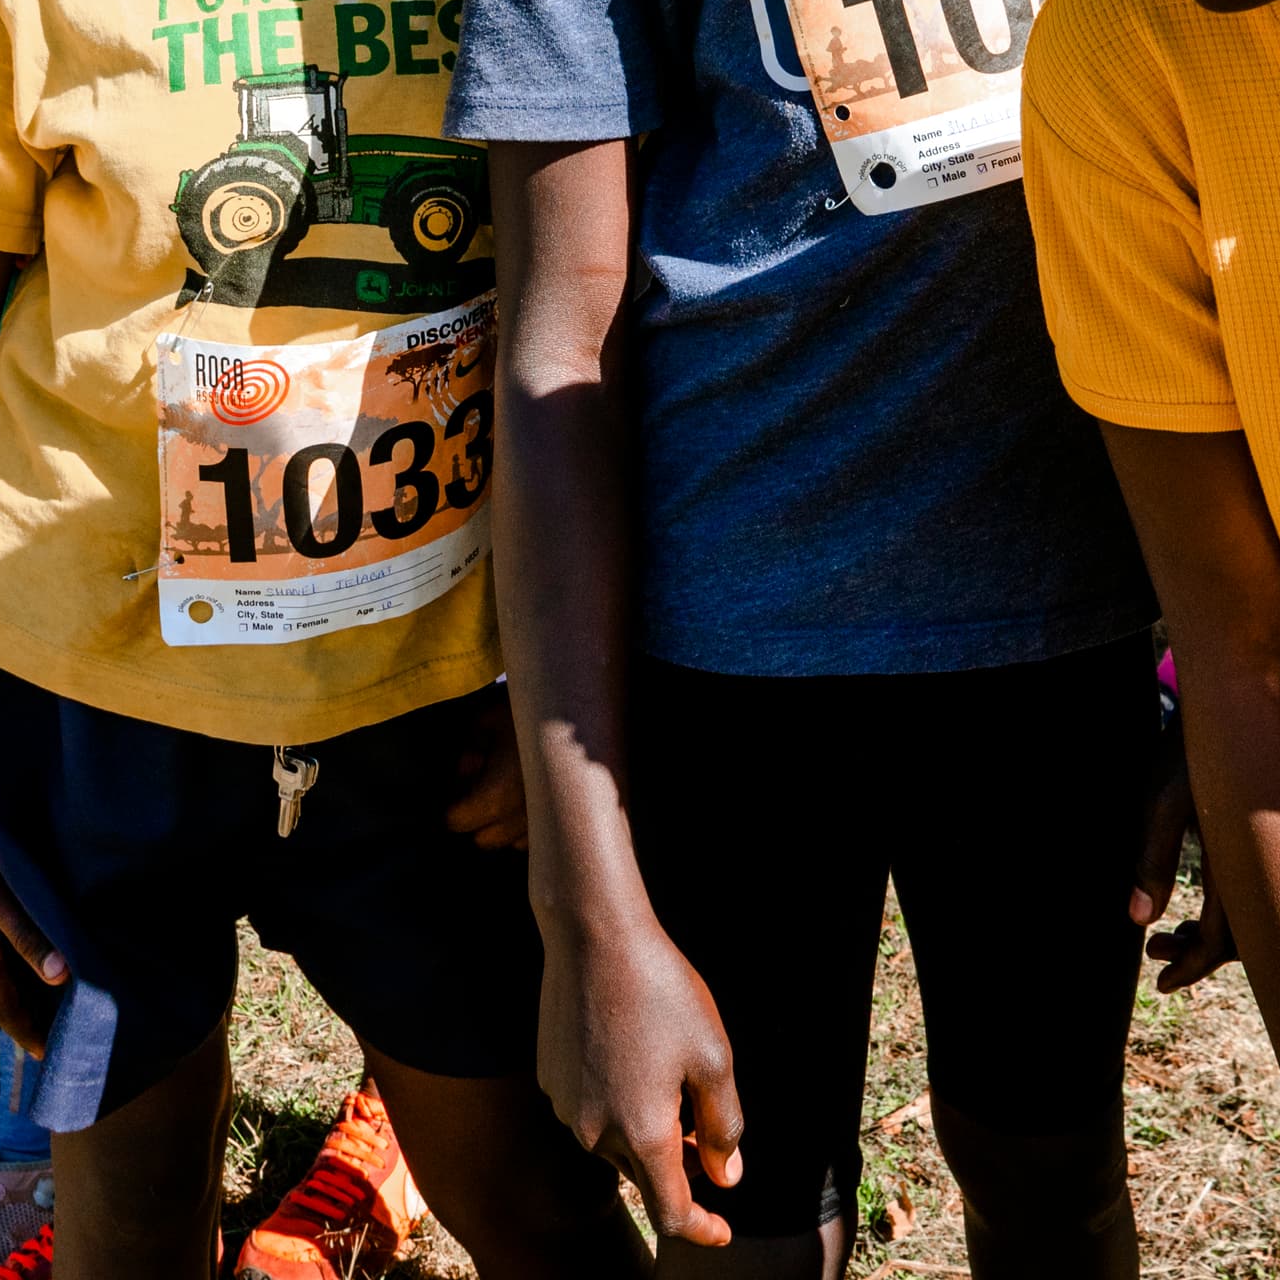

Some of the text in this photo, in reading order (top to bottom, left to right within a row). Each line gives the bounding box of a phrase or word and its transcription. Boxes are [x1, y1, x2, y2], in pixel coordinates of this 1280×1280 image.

[152, 7, 306, 94] THE
[913, 128, 943, 144] Name
[918, 141, 961, 160] Address
[921, 152, 975, 174] City, State
[942, 169, 967, 184] Male
[406, 297, 498, 350] DISCOVERY
[195, 353, 244, 391] ROSA
[198, 389, 495, 563] 1033
[235, 588, 261, 596] Name
[237, 599, 275, 608] Address
[356, 606, 374, 617] Age
[237, 610, 284, 621] City, State
[252, 617, 329, 631] Male Female
